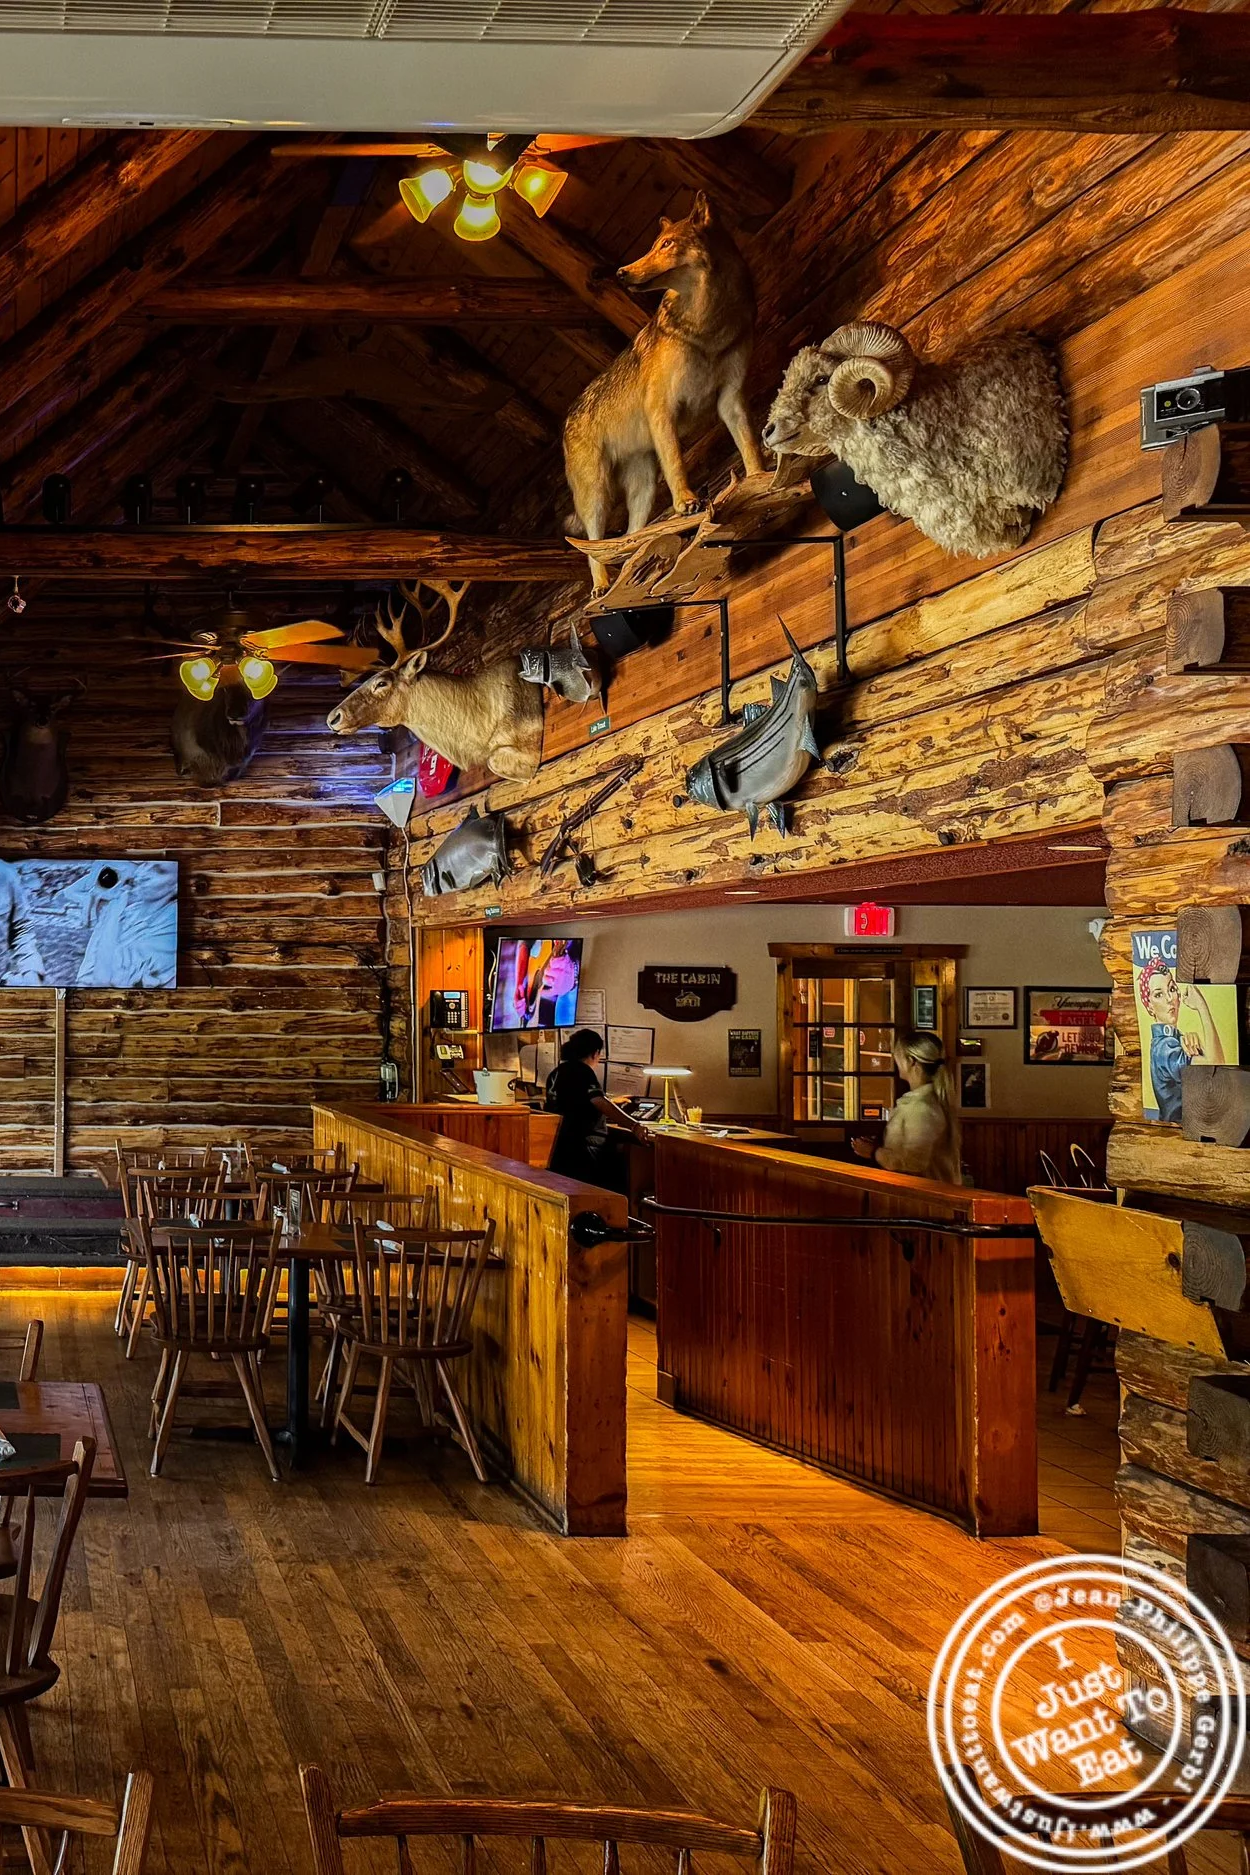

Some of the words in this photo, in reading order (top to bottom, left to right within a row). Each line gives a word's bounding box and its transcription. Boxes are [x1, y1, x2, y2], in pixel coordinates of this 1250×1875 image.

[1135, 936, 1159, 959] We
[654, 972, 678, 984] THE
[680, 973, 721, 985] CABIN
[1052, 996, 1104, 1009] Yuengling
[1058, 1016, 1096, 1026] LAGER
